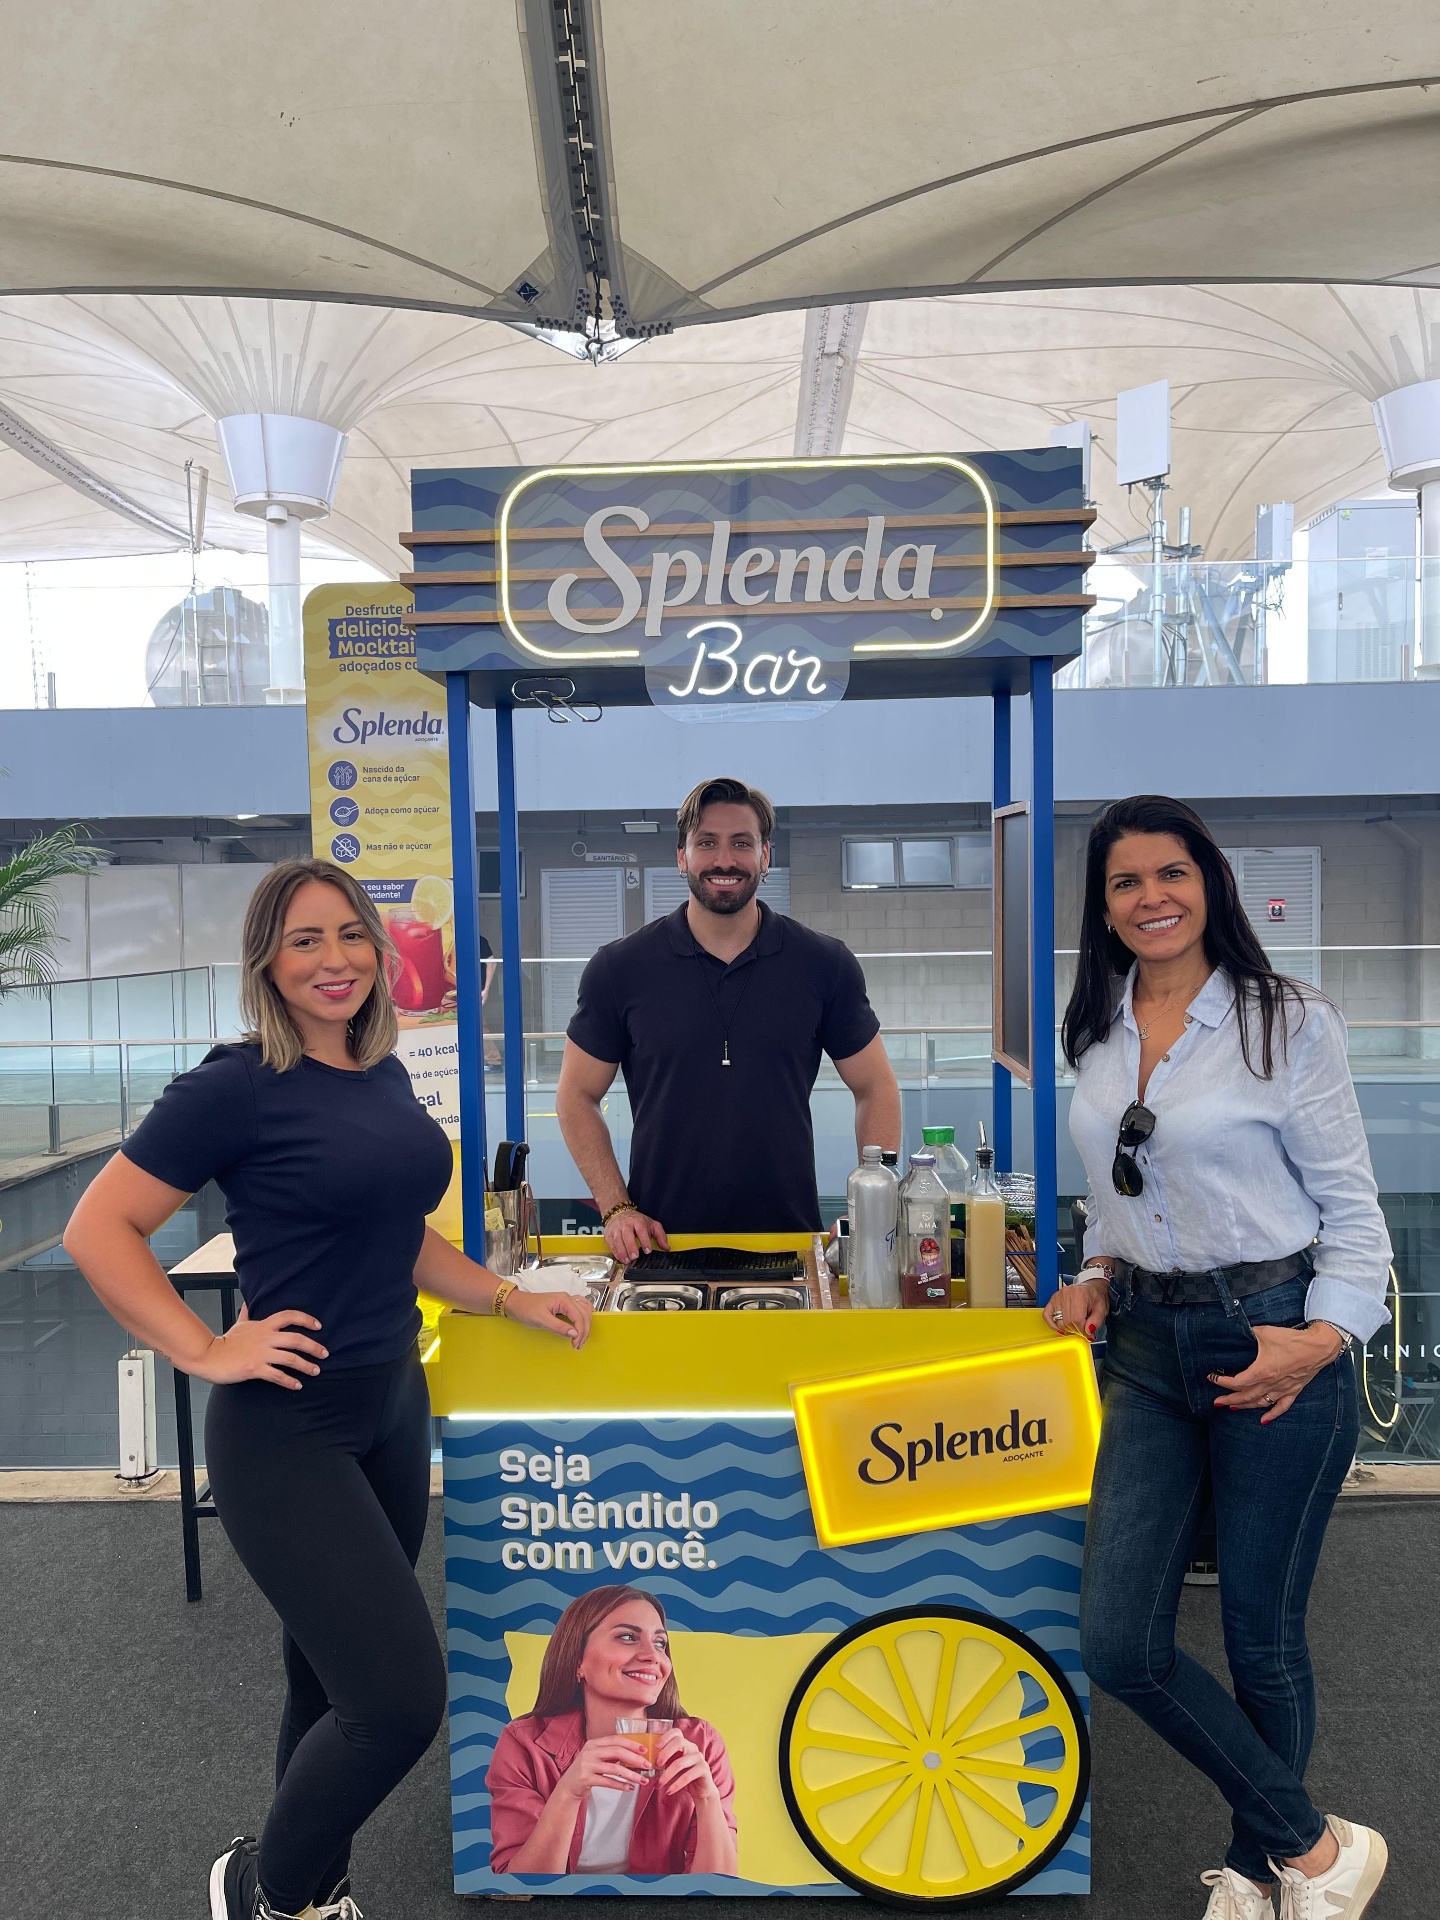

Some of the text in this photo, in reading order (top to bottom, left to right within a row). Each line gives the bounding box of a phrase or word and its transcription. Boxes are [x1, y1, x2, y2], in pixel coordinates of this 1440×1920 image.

[345, 604, 402, 616] Desfrute
[335, 620, 416, 638] delicios
[338, 637, 415, 656] Mocktai
[668, 621, 827, 697] Bar
[339, 659, 402, 674] adoçados
[394, 774, 421, 783] açúcar
[364, 807, 389, 815] Adoça
[413, 806, 440, 814] açúcar
[399, 842, 404, 850] é
[405, 842, 432, 851] açúcar
[418, 1047, 433, 1057] 40
[434, 1043, 459, 1056] kcal
[422, 1071, 433, 1079] de
[1003, 1450, 1045, 1463] ADOÇANTE
[499, 1445, 591, 1489] Seja
[500, 1491, 719, 1537] Splêndido
[501, 1531, 718, 1571] com você.
